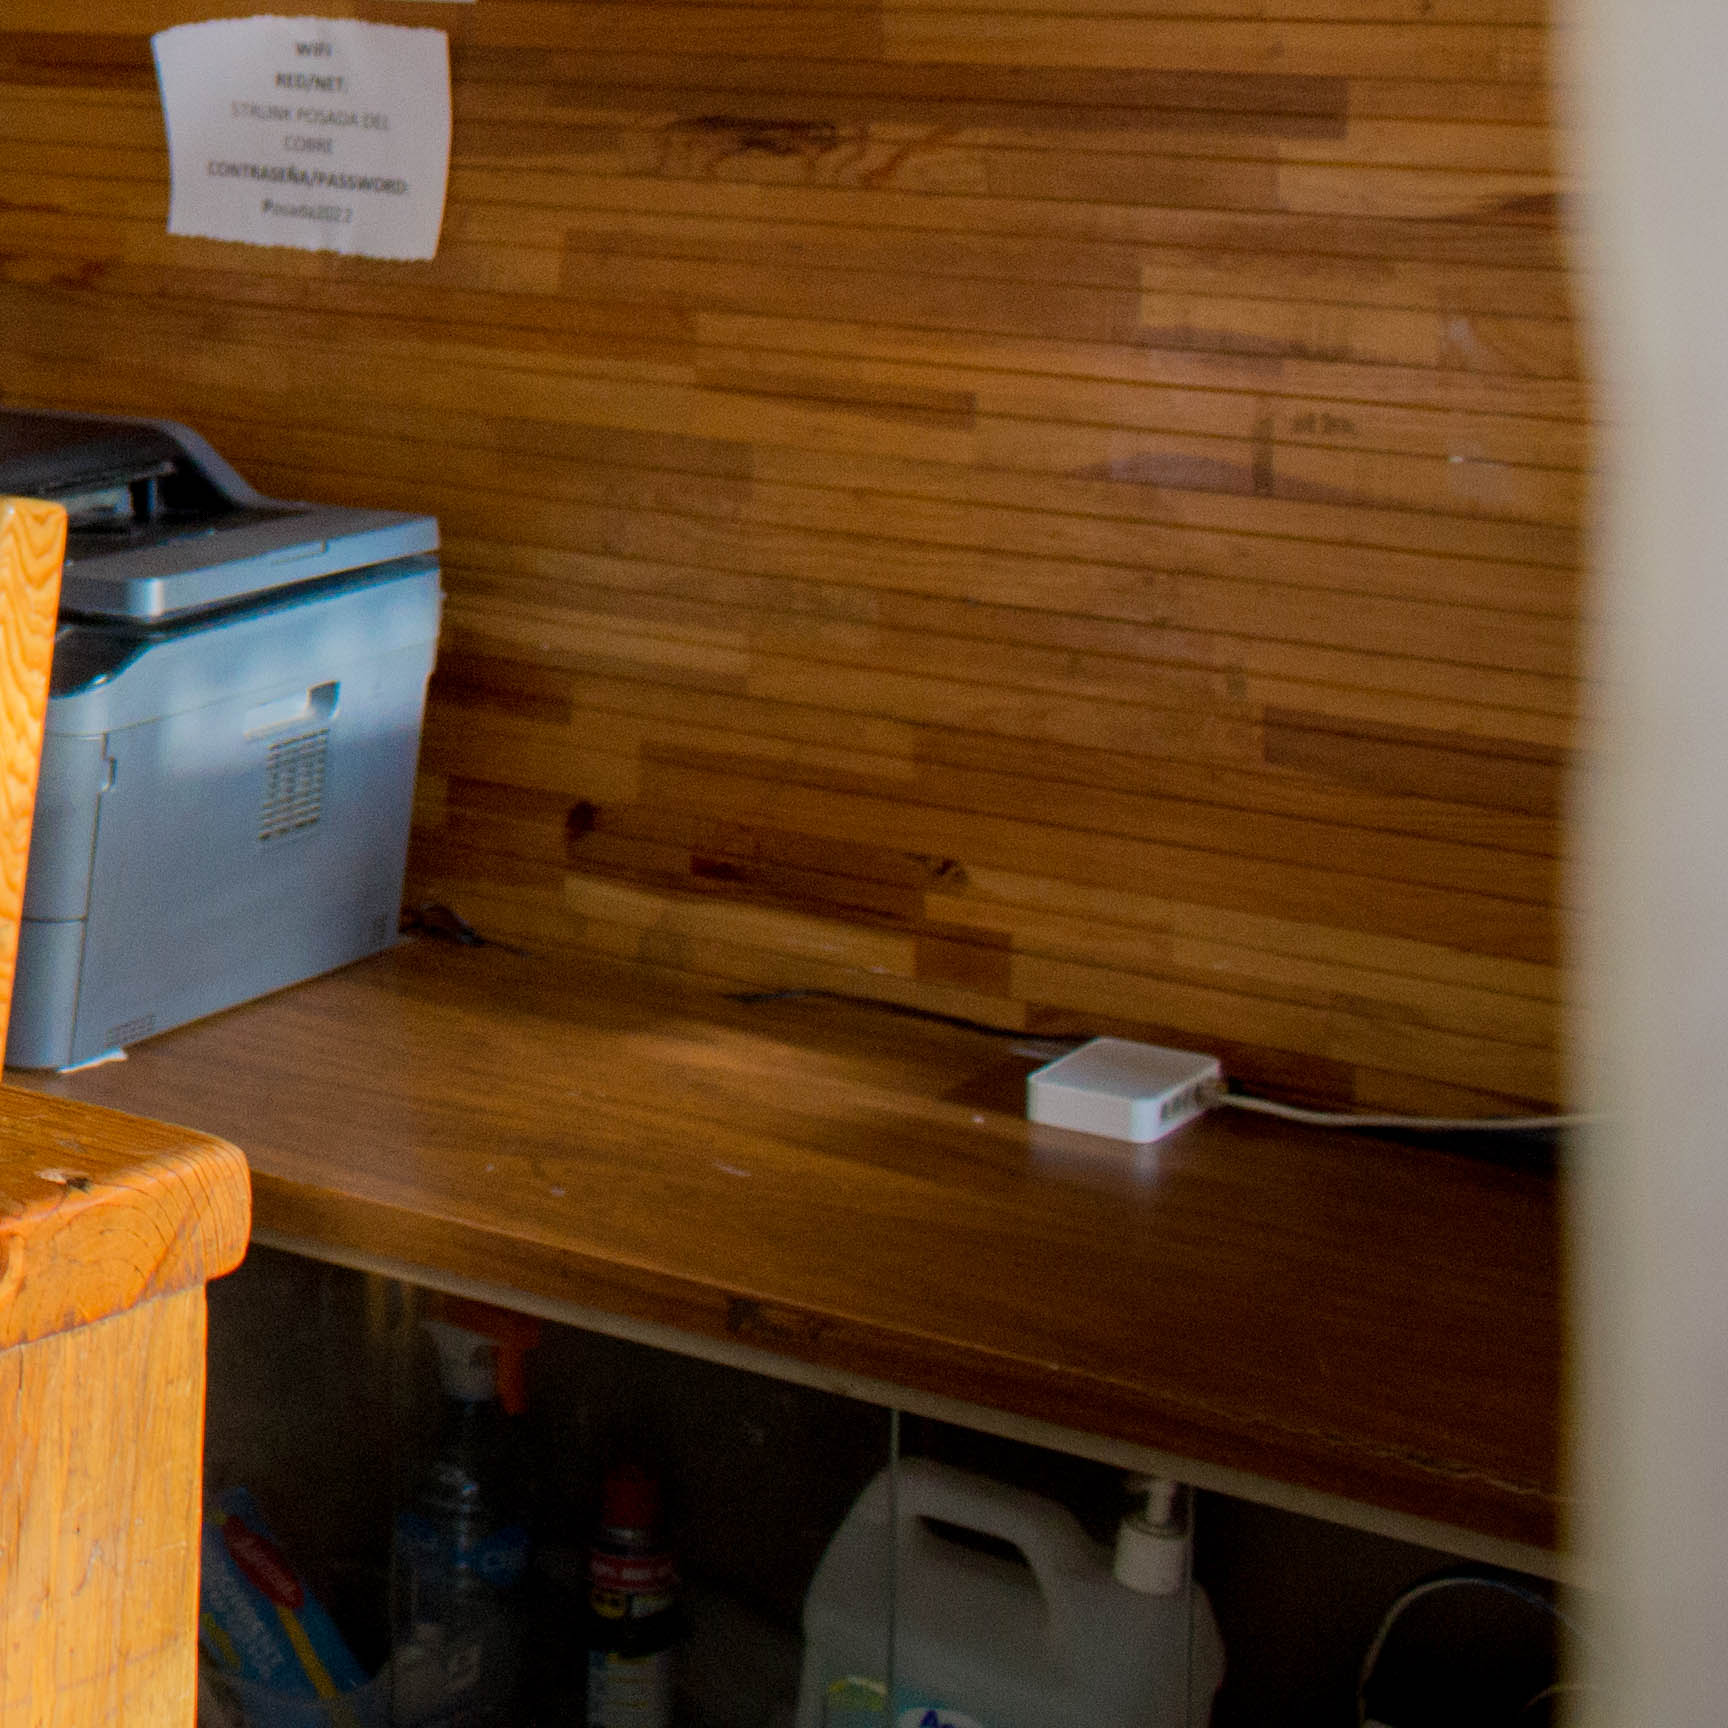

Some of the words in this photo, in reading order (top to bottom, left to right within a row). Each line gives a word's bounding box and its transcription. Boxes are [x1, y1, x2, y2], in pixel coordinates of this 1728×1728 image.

[296, 106, 359, 128] POSADA
[360, 112, 391, 132] DEL
[282, 134, 334, 155] COBRE
